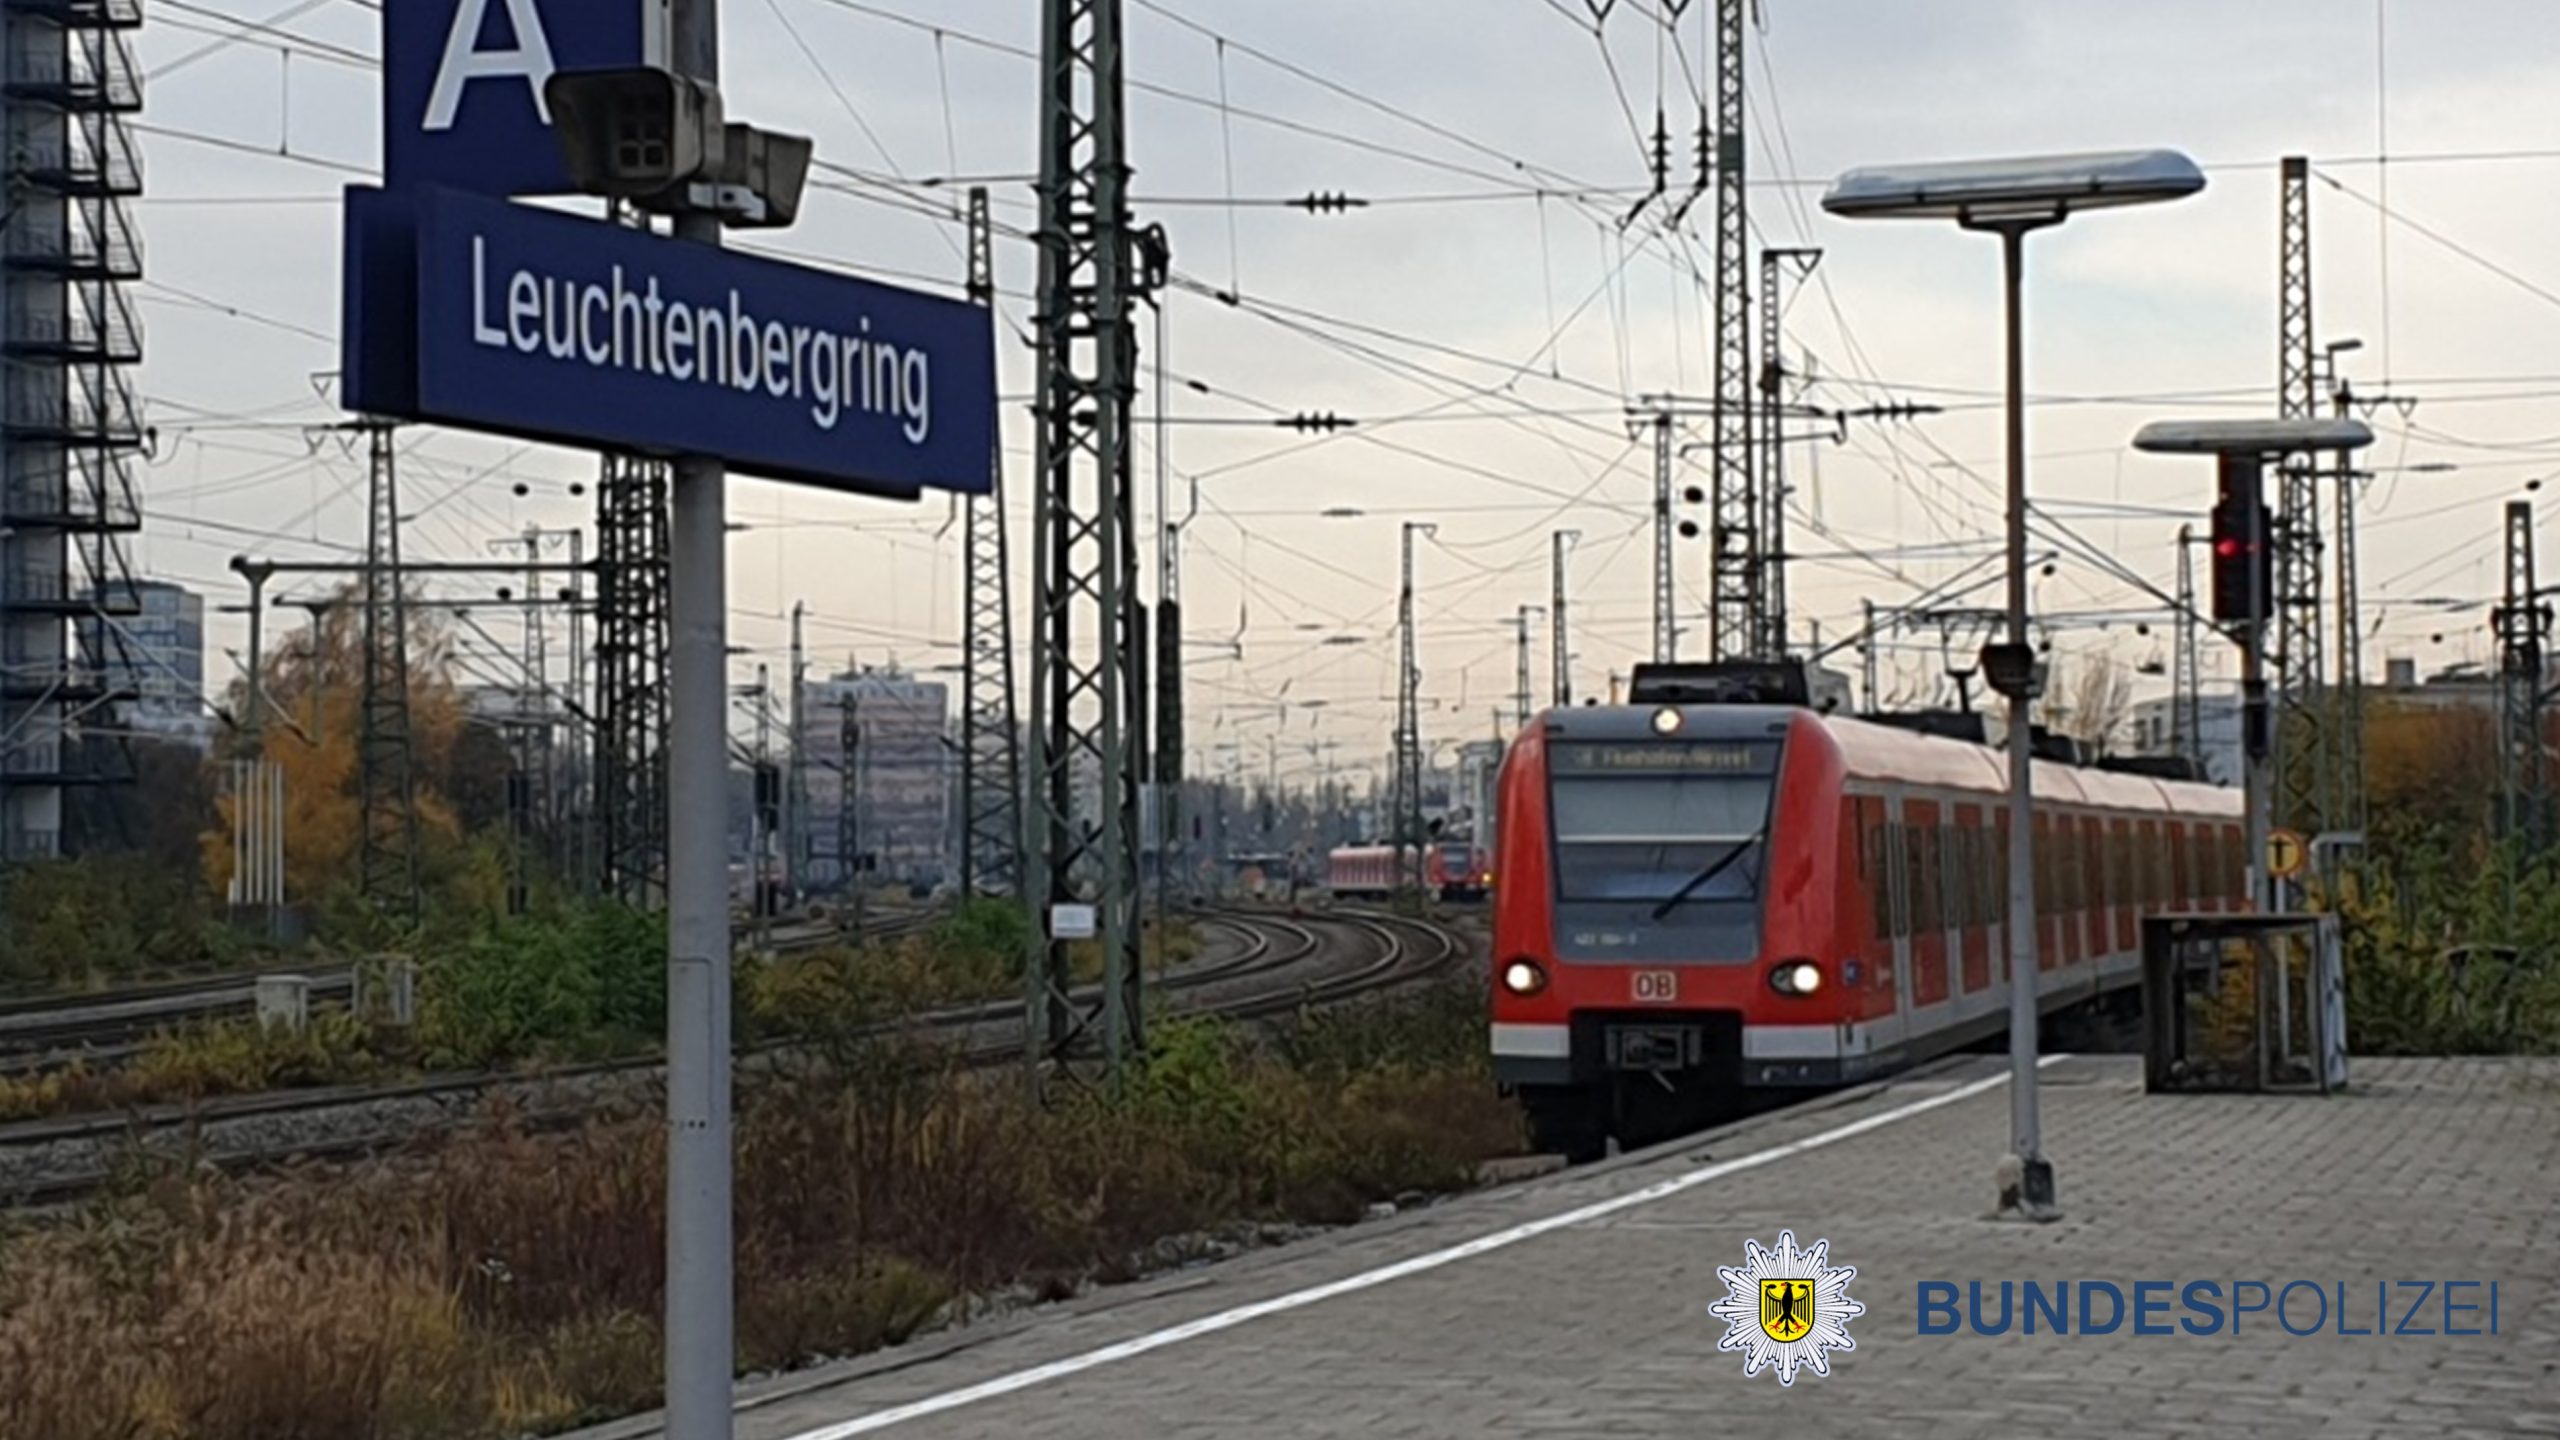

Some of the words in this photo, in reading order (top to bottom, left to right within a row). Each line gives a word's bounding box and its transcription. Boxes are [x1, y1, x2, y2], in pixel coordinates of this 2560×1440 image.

[421, 0, 553, 130] A
[473, 235, 929, 444] Leuchtenbergring
[1635, 972, 1674, 999] DB
